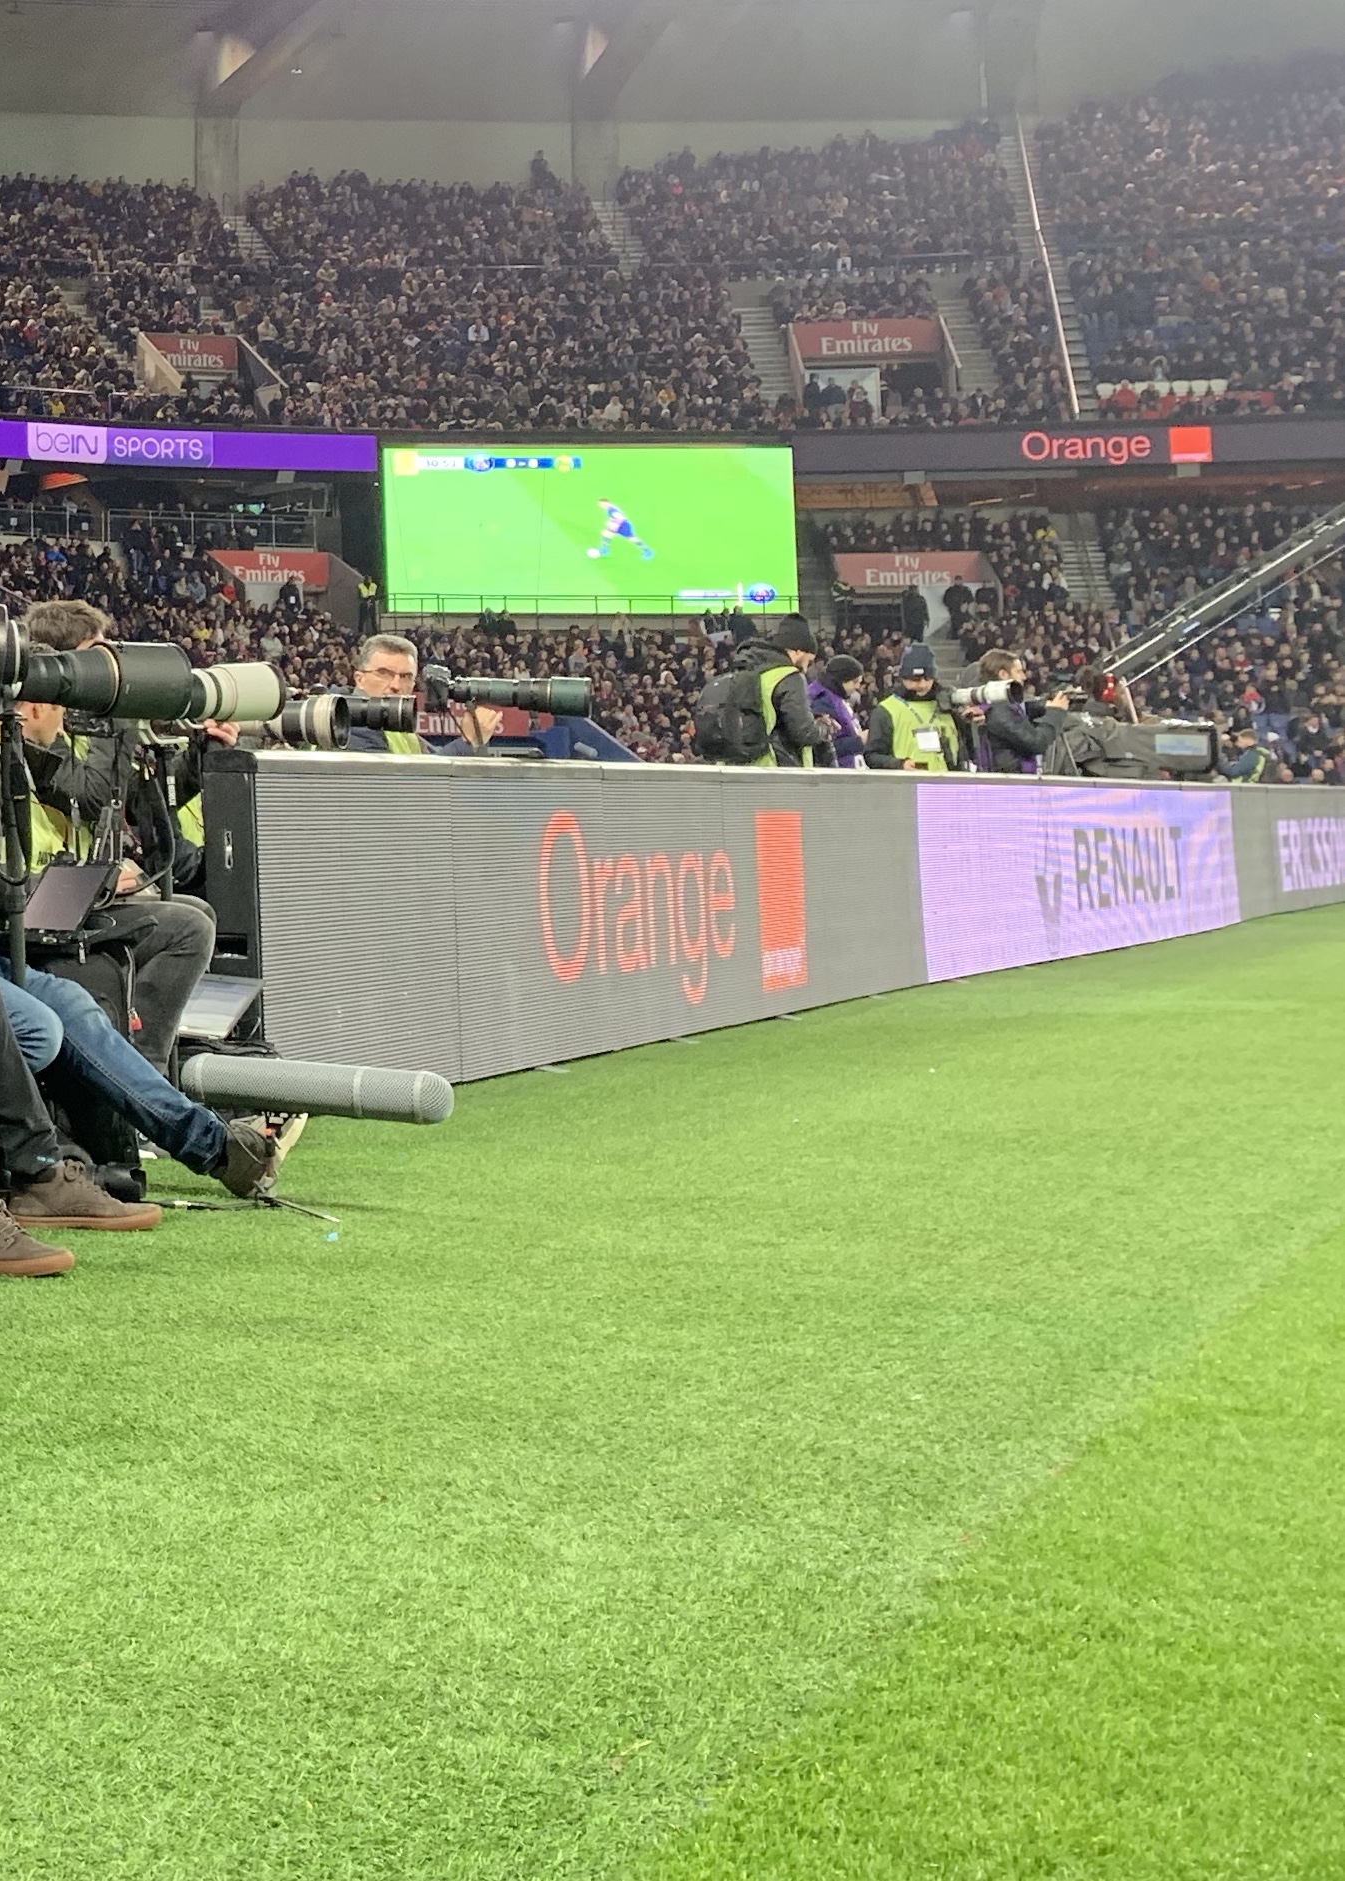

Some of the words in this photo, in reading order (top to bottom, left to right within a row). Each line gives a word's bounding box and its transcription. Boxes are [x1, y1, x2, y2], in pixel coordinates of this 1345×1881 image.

[851, 320, 879, 337] Fly
[179, 338, 200, 352] Fly
[820, 334, 913, 355] Emirates
[35, 425, 98, 455] beIN
[114, 436, 203, 460] SPORTS
[1021, 430, 1151, 466] Orange
[257, 553, 281, 568] Fly
[893, 555, 919, 569] Fly
[233, 566, 305, 583] Emirates
[865, 567, 952, 585] Emirates
[1073, 826, 1182, 910] RENAULT
[539, 811, 736, 1005] Orange
